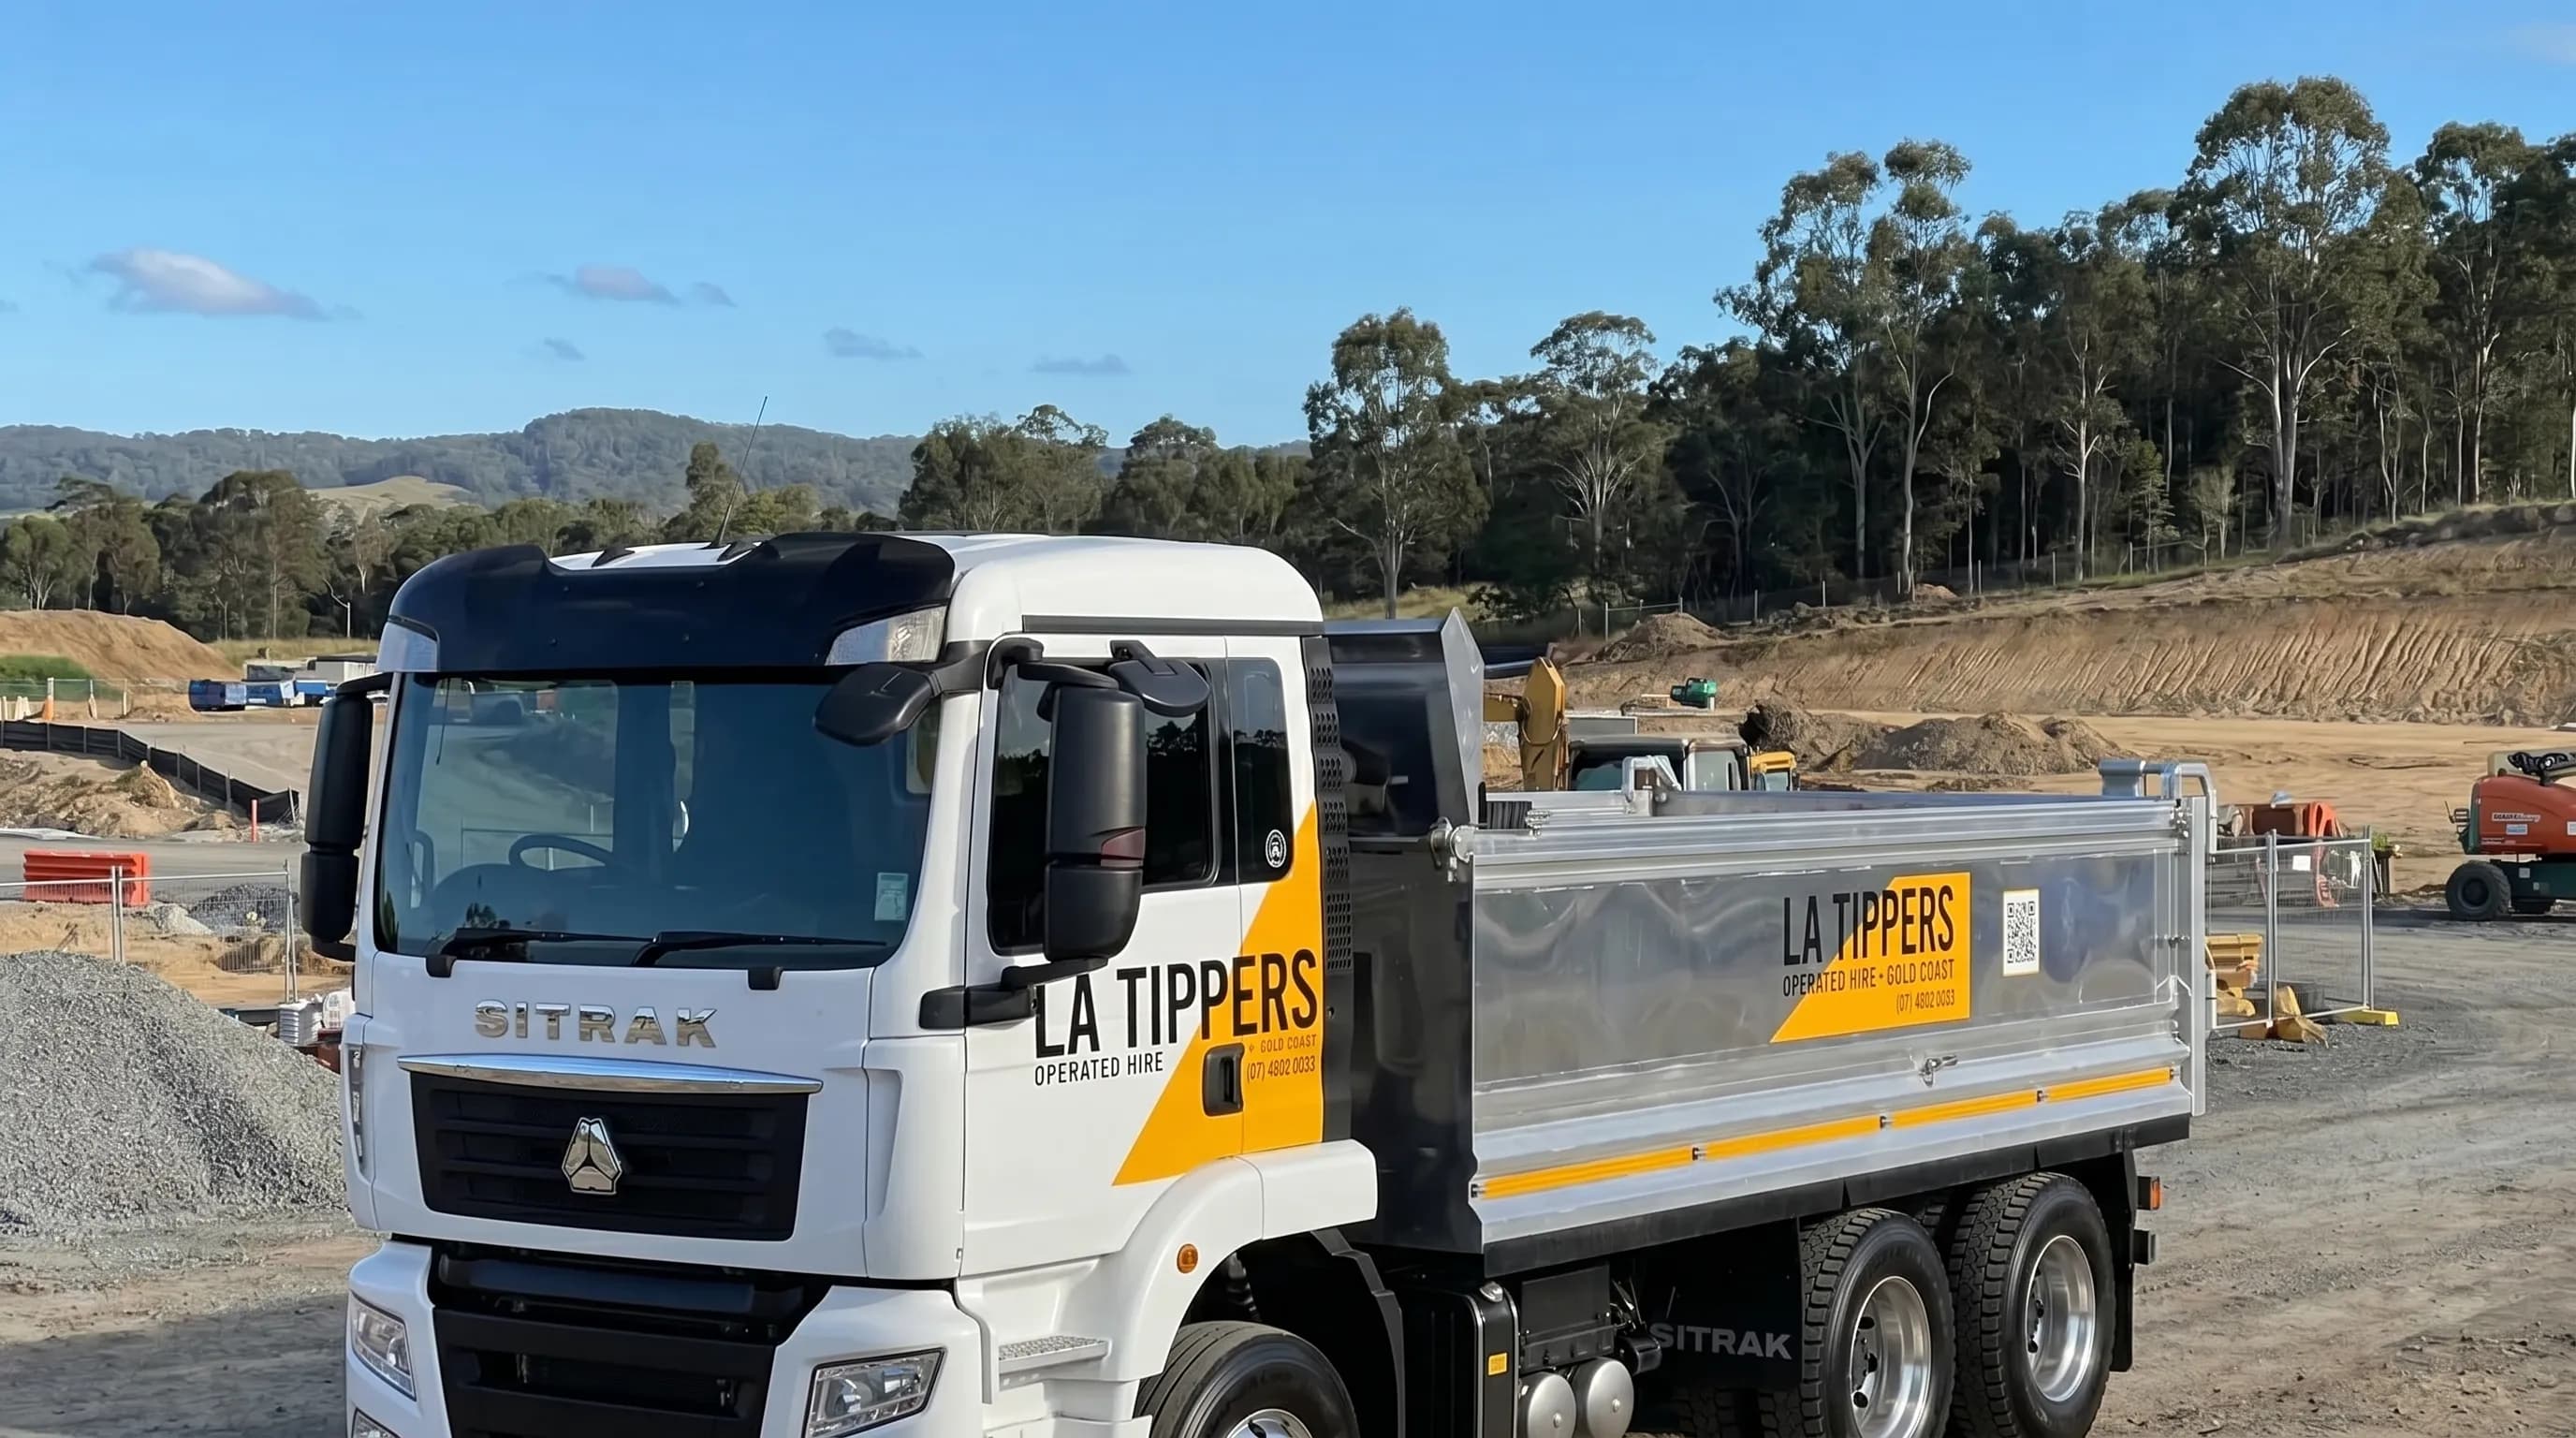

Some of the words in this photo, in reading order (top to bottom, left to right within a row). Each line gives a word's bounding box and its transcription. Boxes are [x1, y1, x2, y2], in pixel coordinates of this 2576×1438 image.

[1784, 896, 1822, 965] LA
[1833, 885, 1954, 961] TIPPERS
[1783, 971, 1845, 996] OPERATED
[1850, 967, 1876, 990] HIRE
[1887, 962, 1916, 986] GOLD
[1920, 959, 1955, 982] COAST
[1035, 974, 1100, 1059] LA
[1117, 948, 1317, 1049] TIPPERS
[1896, 992, 1912, 1016] (07)
[1915, 990, 1935, 1009] 4802
[475, 999, 717, 1048] SITRAK
[1261, 1037, 1284, 1053] GOLD
[1287, 1034, 1317, 1049] COAST
[1034, 1057, 1120, 1086] OPERATED
[1128, 1051, 1164, 1076] HIRE
[1247, 1062, 1266, 1084] (07)
[1268, 1058, 1291, 1077] 4802
[1293, 1055, 1316, 1074] 0033
[1649, 1322, 1793, 1360] SITRAK
